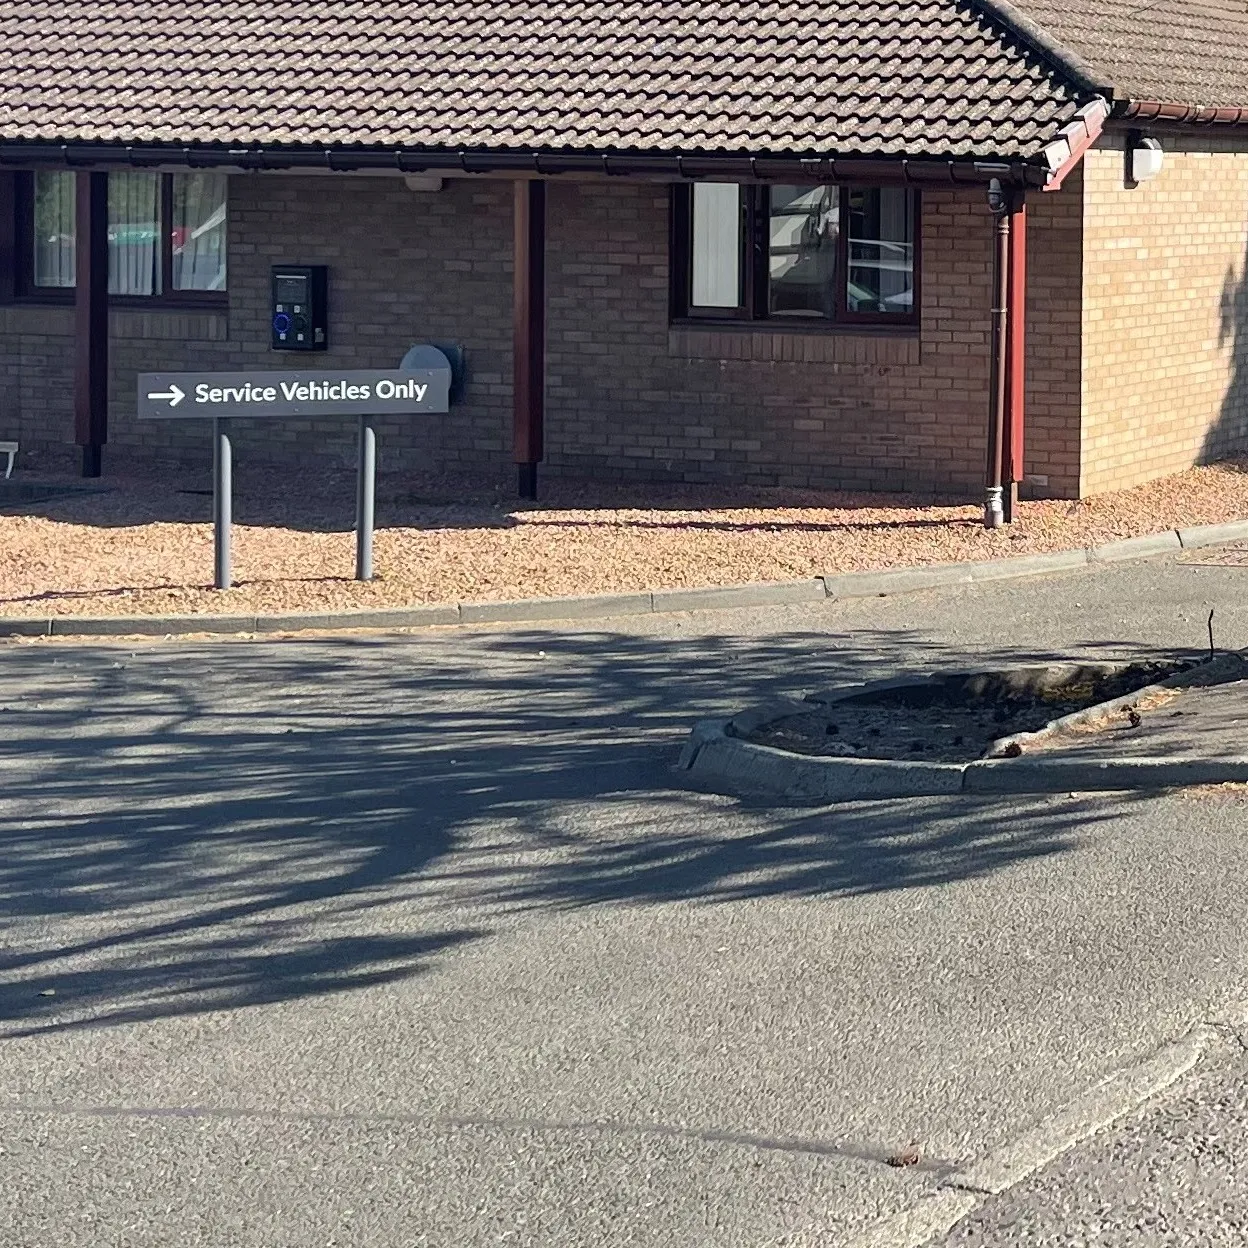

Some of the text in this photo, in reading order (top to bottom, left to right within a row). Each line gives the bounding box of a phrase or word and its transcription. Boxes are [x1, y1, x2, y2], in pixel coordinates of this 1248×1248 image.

[195, 379, 428, 402] Service Vehicles Only
